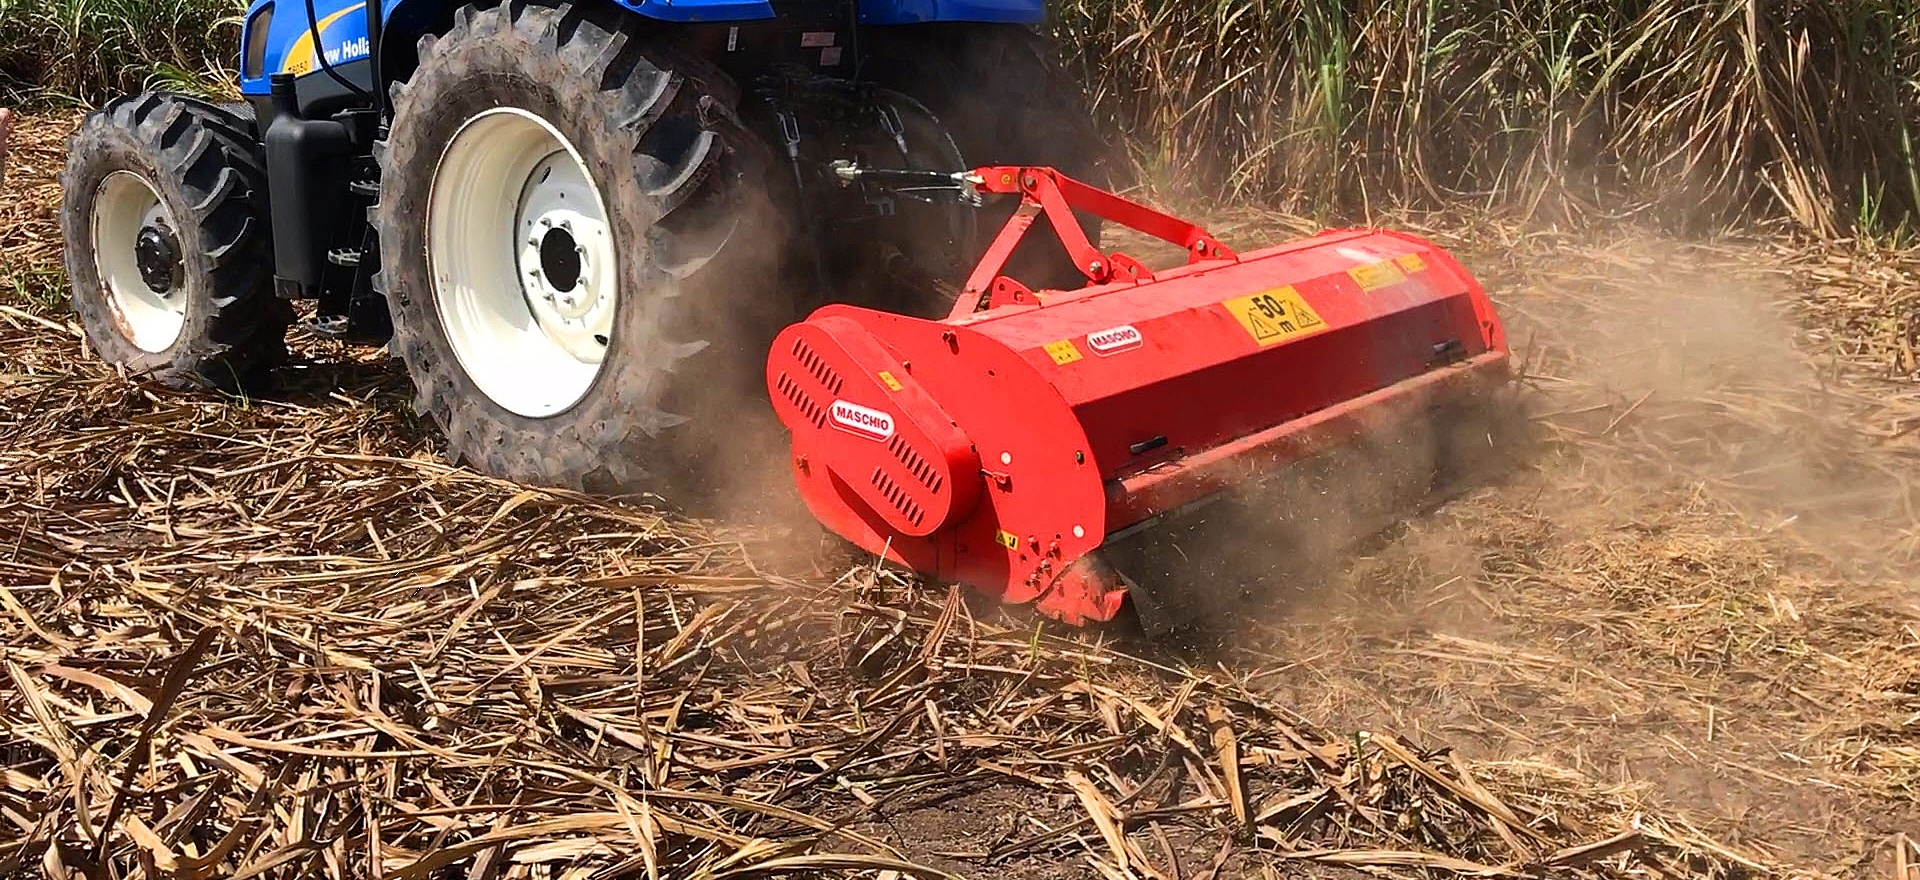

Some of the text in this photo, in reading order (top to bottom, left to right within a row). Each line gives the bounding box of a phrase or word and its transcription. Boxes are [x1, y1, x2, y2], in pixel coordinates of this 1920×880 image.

[1251, 294, 1286, 319] 50
[1278, 320, 1297, 333] m
[1092, 329, 1137, 346] MASCHIO
[836, 405, 889, 431] MASCHIO
